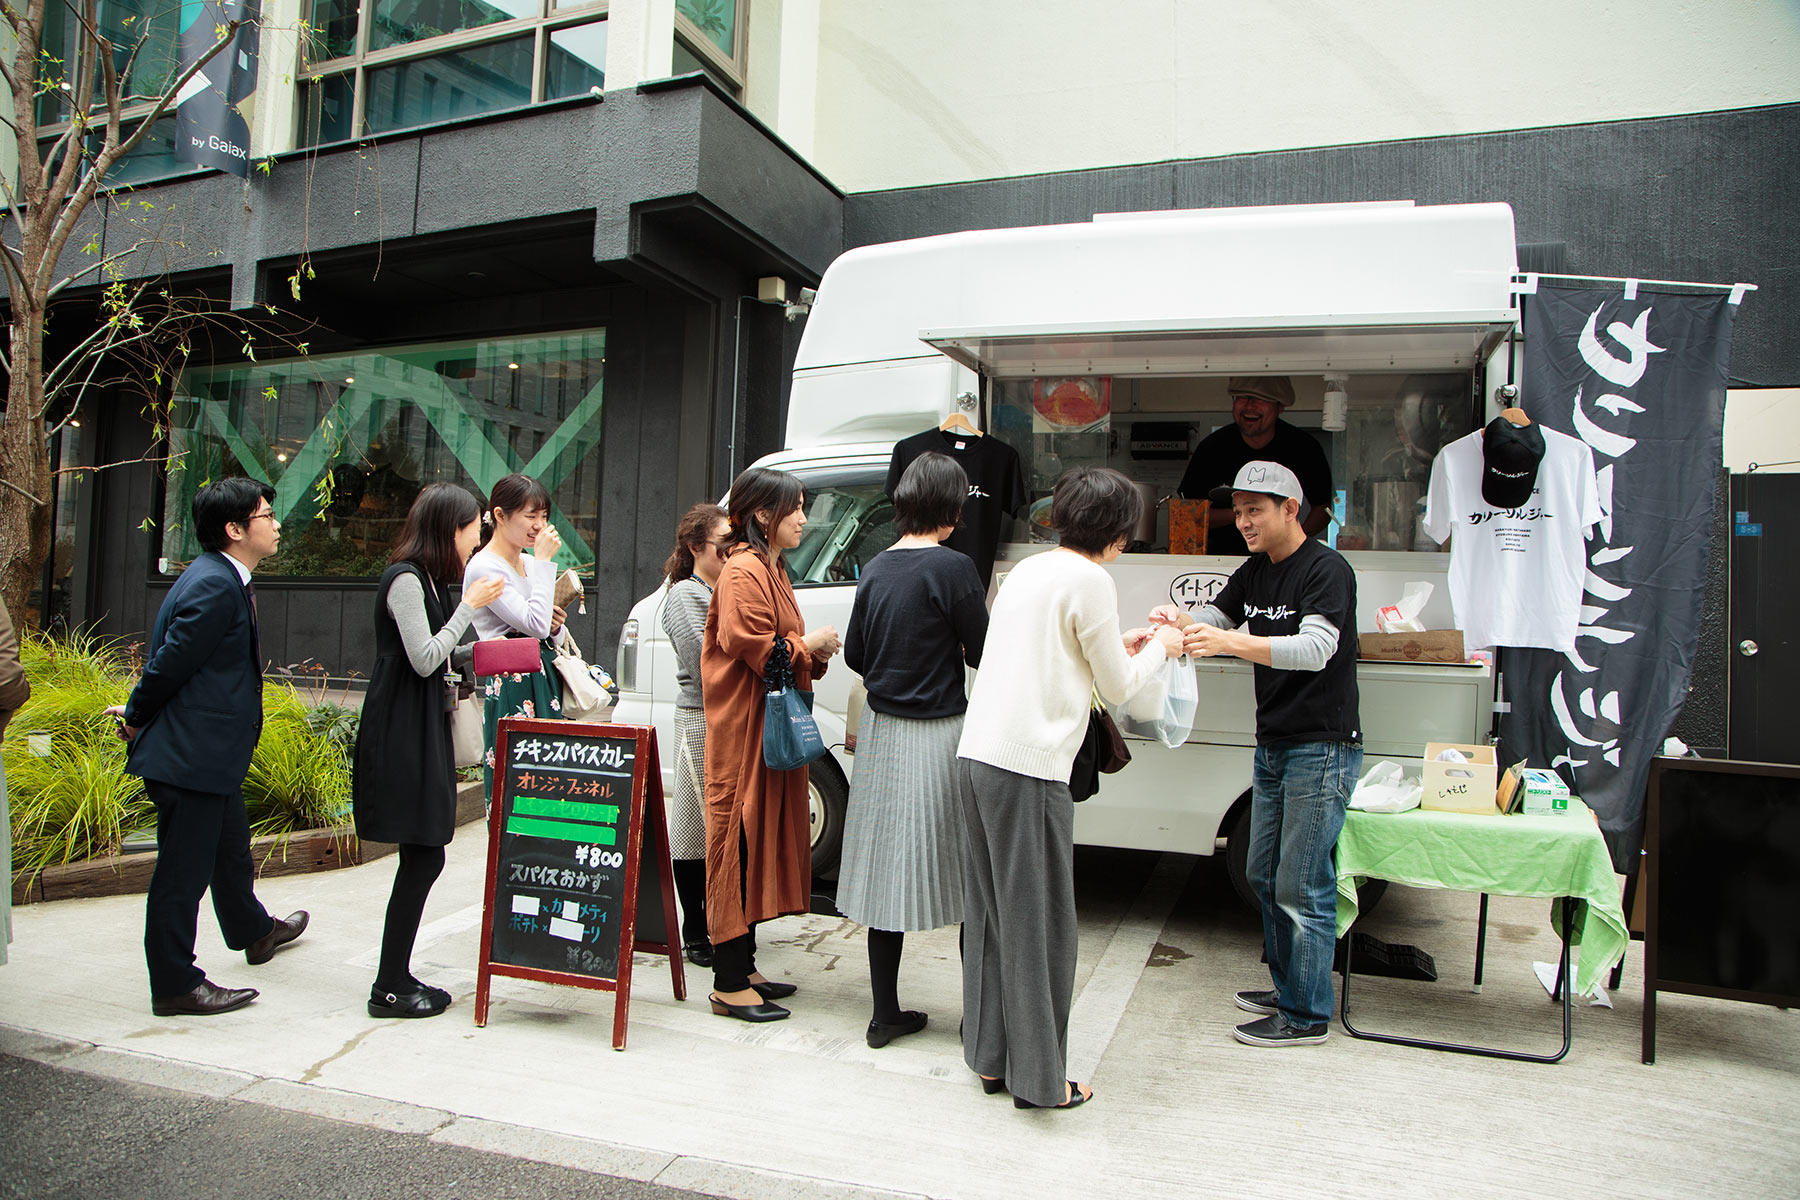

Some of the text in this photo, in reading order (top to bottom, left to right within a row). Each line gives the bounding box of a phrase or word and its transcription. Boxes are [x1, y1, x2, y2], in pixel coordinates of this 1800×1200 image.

[191, 135, 247, 161] by Gaiax
[1175, 578, 1223, 597] イートイ
[513, 738, 636, 768] チキンスパイスカレー
[575, 844, 624, 869] ¥800
[508, 863, 610, 893] スパイスおかず
